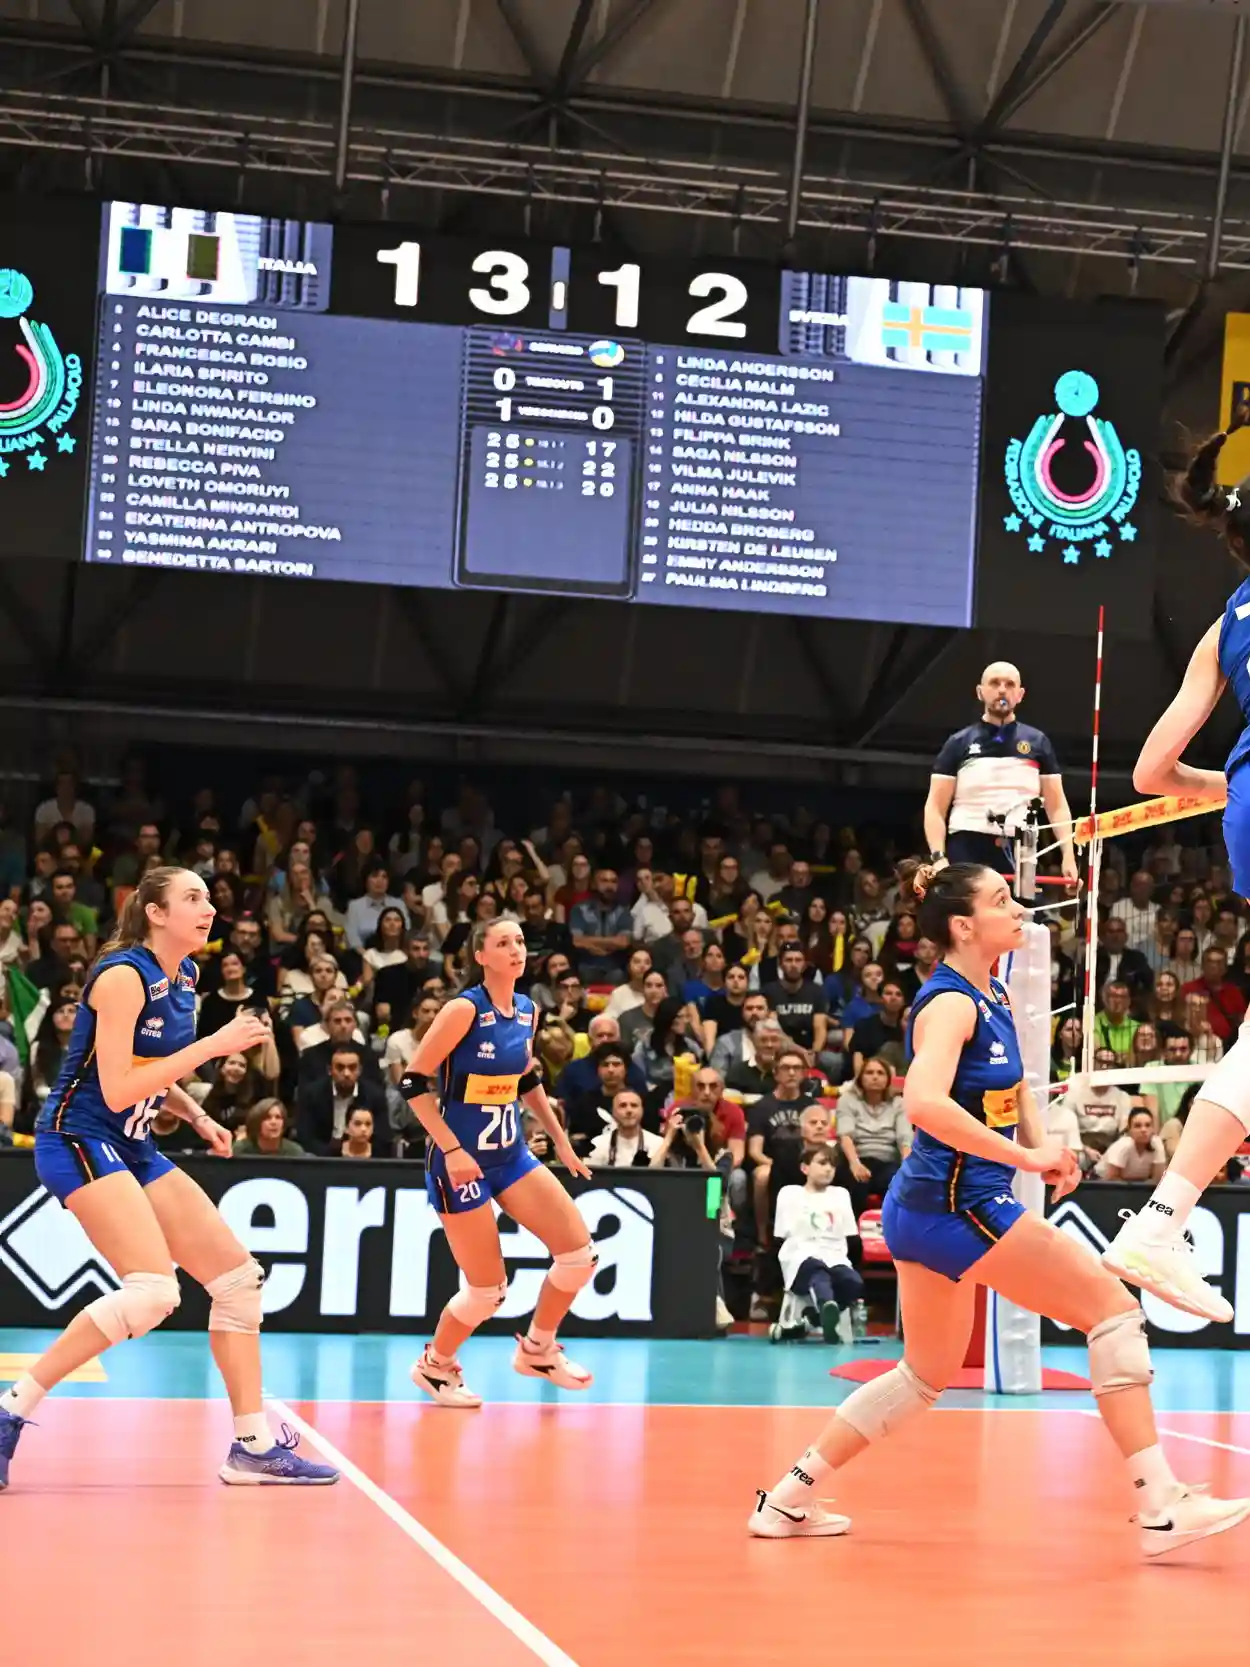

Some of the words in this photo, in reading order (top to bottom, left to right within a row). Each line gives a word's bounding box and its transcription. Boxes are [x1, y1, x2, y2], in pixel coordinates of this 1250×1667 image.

[136, 305, 191, 322] ALICE
[195, 310, 277, 329] DEGRADI
[136, 324, 234, 344] CARLOTTA
[135, 342, 247, 364] FRANCESCA
[134, 361, 197, 379] ILARIA
[493, 367, 516, 391] 0
[677, 355, 728, 373] LINDA
[729, 361, 834, 382] ANDERSSON
[133, 380, 235, 400] ELEONORA
[597, 376, 613, 400] 1
[676, 373, 742, 393] CECILIA
[745, 380, 795, 396] MALM
[132, 398, 188, 416] LINDA
[496, 397, 512, 421] 1
[674, 391, 777, 412] ALEXANDRA
[592, 406, 615, 429] 0
[674, 409, 726, 427] HILDA
[728, 414, 840, 437] GUSTAFSSON
[131, 417, 182, 434] SARA
[185, 423, 284, 442] BONIFACIO
[130, 436, 200, 455] STELLA
[203, 443, 275, 461] NERVINI
[586, 441, 617, 457] 17
[738, 434, 792, 451] BRINK
[128, 454, 217, 475] REBECCA
[220, 462, 261, 479] PIVA
[672, 444, 720, 462] SAGA
[723, 449, 797, 468] NILSSON
[128, 473, 201, 493] LOVETH
[671, 463, 723, 481] VILMA
[726, 468, 796, 486] JULEVIK
[126, 492, 206, 512] CAMILLA
[670, 482, 718, 498] ANNA
[722, 486, 770, 502] HAAK
[669, 500, 718, 516] JULIA
[721, 504, 795, 522] NILSSON
[125, 510, 227, 532] EKATERINA
[230, 520, 342, 542] ANTROPOVA
[669, 518, 727, 536] HEDDA
[207, 537, 277, 555] AKRARI
[743, 541, 768, 557] DE
[719, 559, 825, 580] ANDERSSON
[478, 1105, 518, 1150] 20
[460, 1181, 482, 1203] 20
